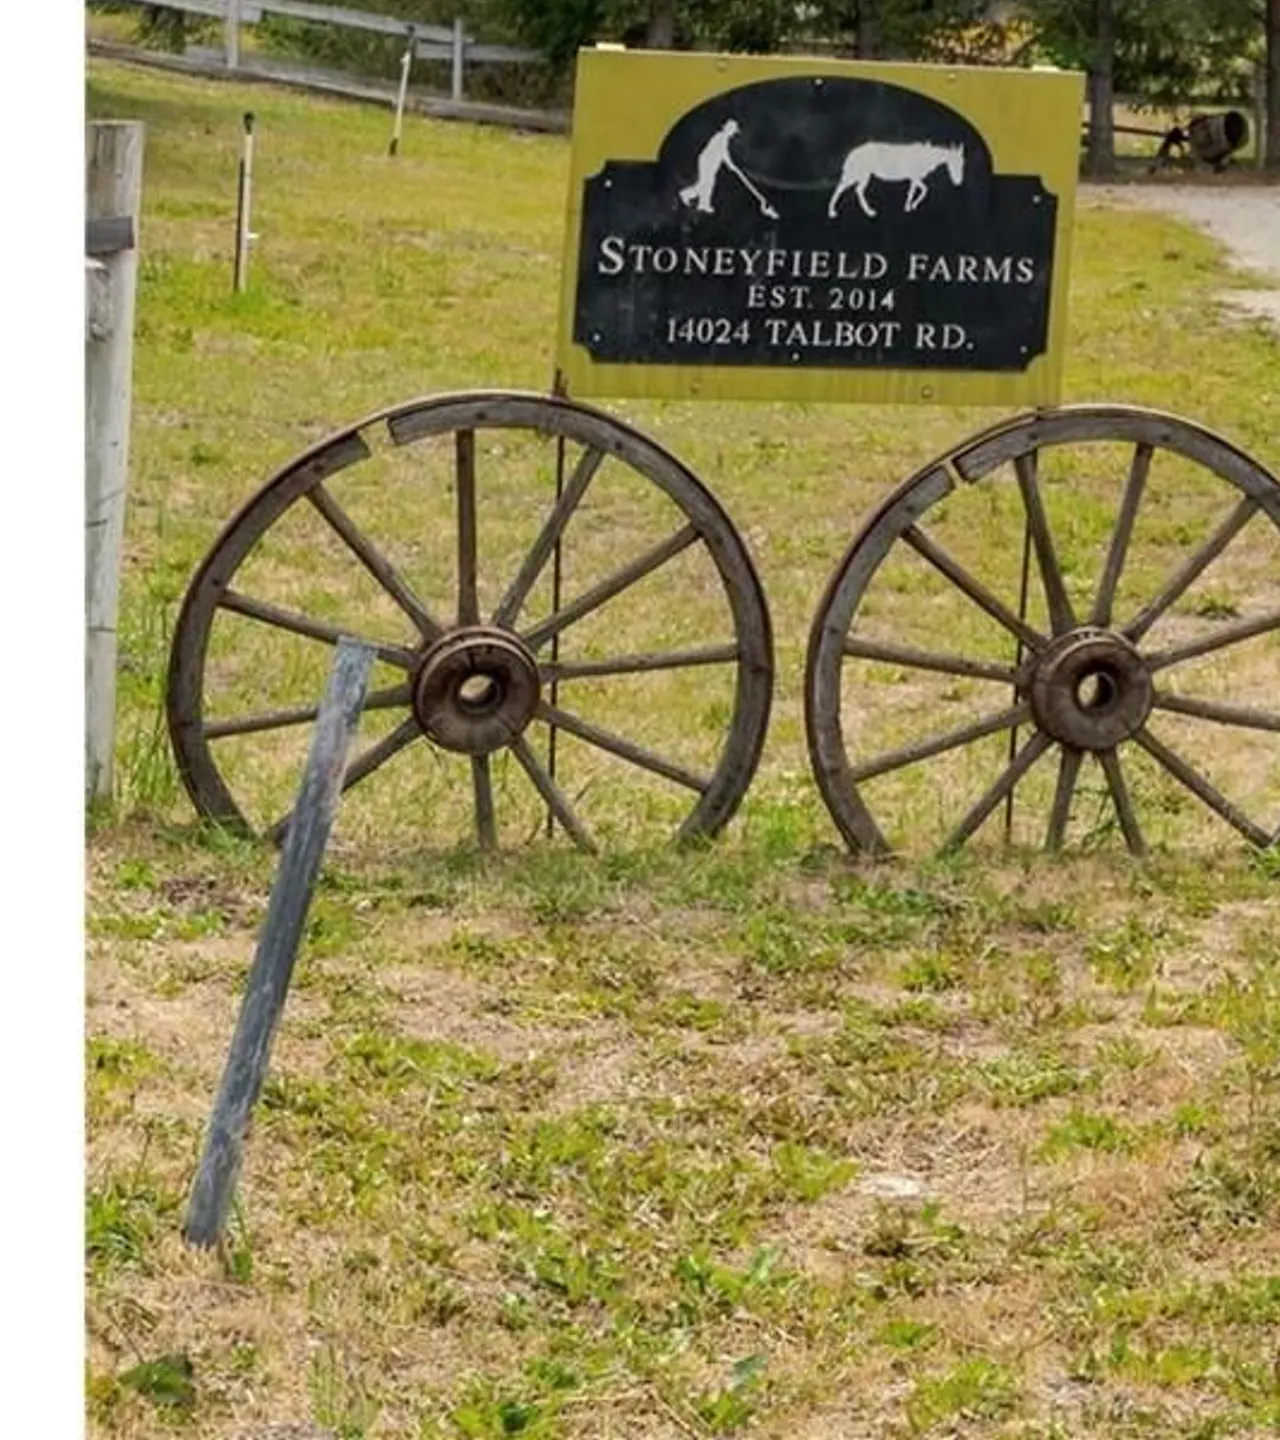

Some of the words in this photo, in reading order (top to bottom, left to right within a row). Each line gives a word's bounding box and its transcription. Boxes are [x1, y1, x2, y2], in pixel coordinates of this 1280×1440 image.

[907, 253, 1034, 284] FARMS
[747, 284, 814, 310] EST.
[829, 287, 895, 311] 2014
[667, 317, 750, 345] 14024
[765, 318, 901, 349] TALBOT
[915, 323, 975, 351] RD.
